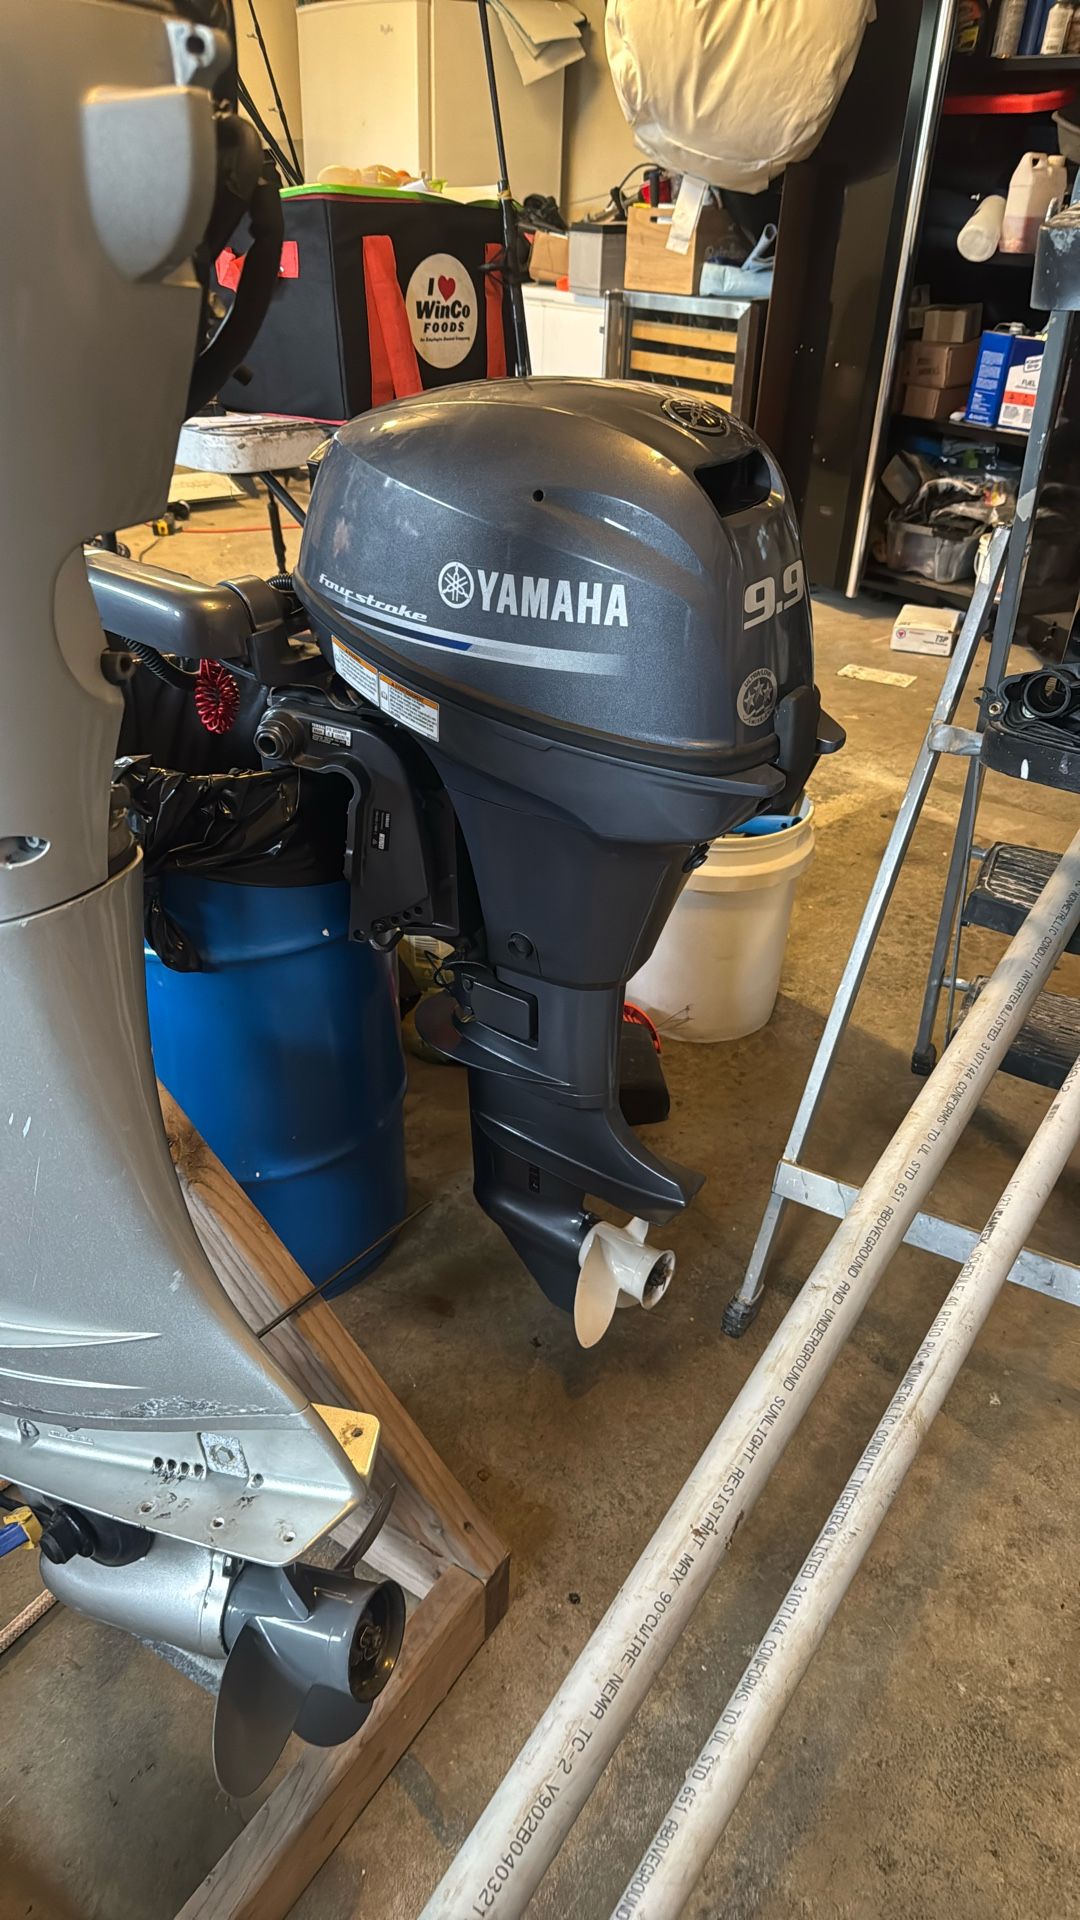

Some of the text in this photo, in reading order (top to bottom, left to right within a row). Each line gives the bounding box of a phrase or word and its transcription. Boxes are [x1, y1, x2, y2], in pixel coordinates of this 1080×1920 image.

[428, 278, 434, 296] I
[416, 300, 470, 319] WinCo
[423, 322, 464, 333] FOODS
[478, 568, 628, 627] YAMAHA
[744, 559, 805, 631] 9.9
[1031, 935, 1053, 969] CONDUIT
[965, 1042, 991, 1080] 3107144
[937, 1081, 968, 1126] CONFORMS
[918, 1143, 932, 1156] UL
[928, 1128, 940, 1141] TO
[905, 1160, 921, 1180] STD
[892, 1183, 908, 1202] 651
[848, 1205, 894, 1278] ABOVEGROUND
[831, 1280, 851, 1305] AND
[783, 1308, 836, 1392] UNDERGROUND
[917, 1341, 936, 1359] PVC
[744, 1396, 786, 1464] SUNLIGHT
[858, 1430, 889, 1474] CONDUIT
[693, 1467, 745, 1551] RESISTANT
[669, 1552, 696, 1586] MAX
[771, 1585, 807, 1635] 3107144
[735, 1640, 777, 1702] CONFORMS
[589, 1673, 624, 1721] NEMA
[723, 1709, 741, 1725] TO
[558, 1727, 593, 1776] TC-2
[709, 1729, 729, 1745] UL
[692, 1753, 715, 1781] STD
[675, 1786, 696, 1815] 651
[473, 1784, 560, 1919] V902B040321
[616, 1819, 679, 1920] ABOVEGROUND
